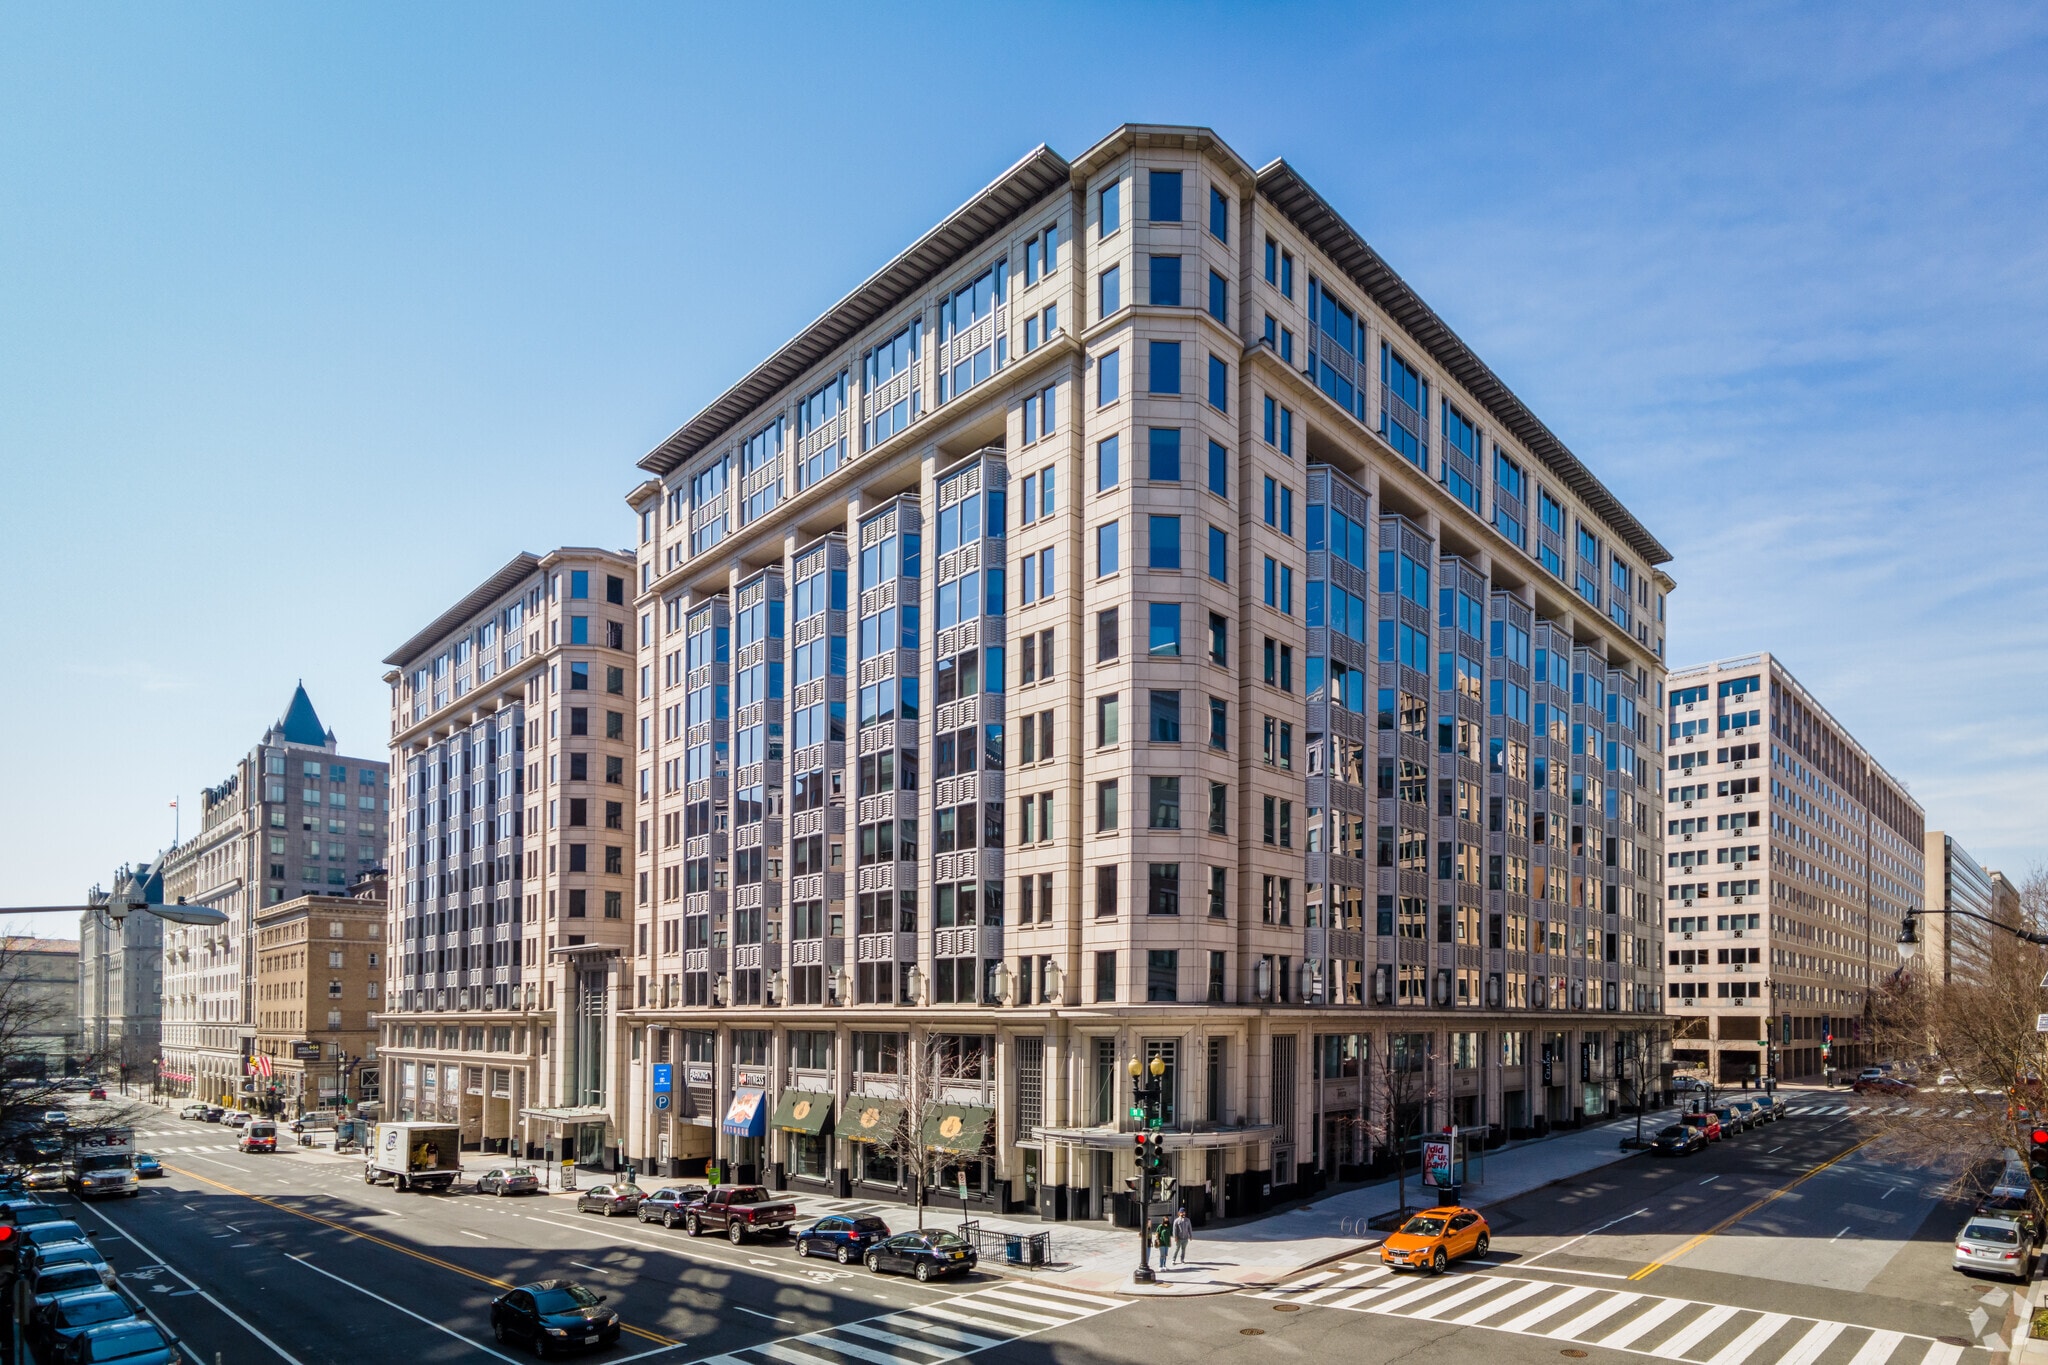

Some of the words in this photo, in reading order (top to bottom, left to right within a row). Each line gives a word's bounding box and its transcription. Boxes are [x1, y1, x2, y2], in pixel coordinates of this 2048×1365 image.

[746, 1073, 765, 1085] FITNESS
[659, 1097, 667, 1108] P
[81, 1134, 128, 1148] FedEx
[1430, 1144, 1444, 1154] did
[1426, 1162, 1447, 1170] part?
